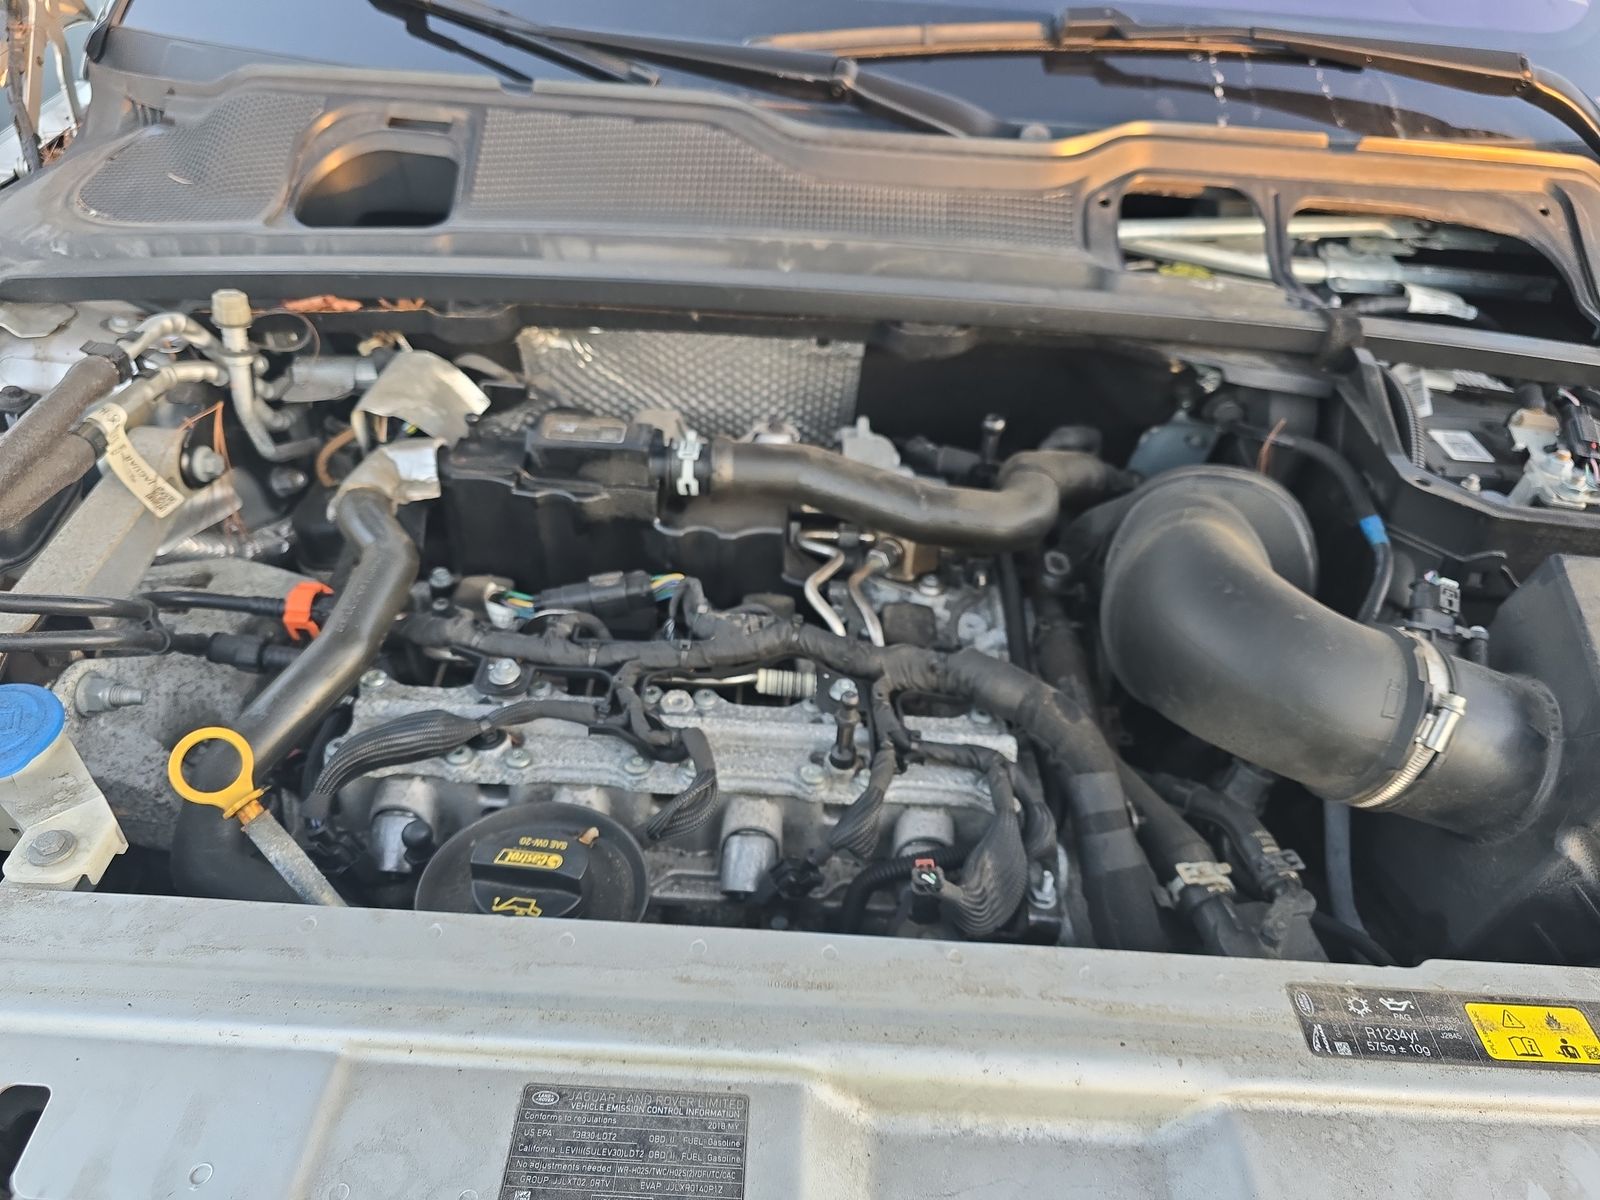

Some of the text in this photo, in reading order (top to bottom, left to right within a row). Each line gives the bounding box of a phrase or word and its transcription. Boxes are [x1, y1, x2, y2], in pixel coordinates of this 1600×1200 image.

[519, 836, 568, 850] SAE 0W-20
[504, 851, 549, 867] Castrol
[1393, 1012, 1412, 1021] PAG
[1364, 1026, 1420, 1044] R1234yf
[1440, 1031, 1463, 1040] J2845
[1366, 1041, 1397, 1054] 575g
[1409, 1043, 1431, 1056] 10g
[568, 1090, 744, 1110] JAGUAR LAND ROVER LIMITED
[571, 1102, 740, 1118] VEHICLE EMISSION CONTROL INFORMATION
[564, 1114, 572, 1122] to
[573, 1114, 617, 1124] regulations
[707, 1121, 740, 1131] 2018 MY
[523, 1128, 535, 1137] US
[707, 1137, 741, 1148] Gasoline
[707, 1153, 741, 1164] Gasoline
[516, 1160, 612, 1173] No adjustments needed
